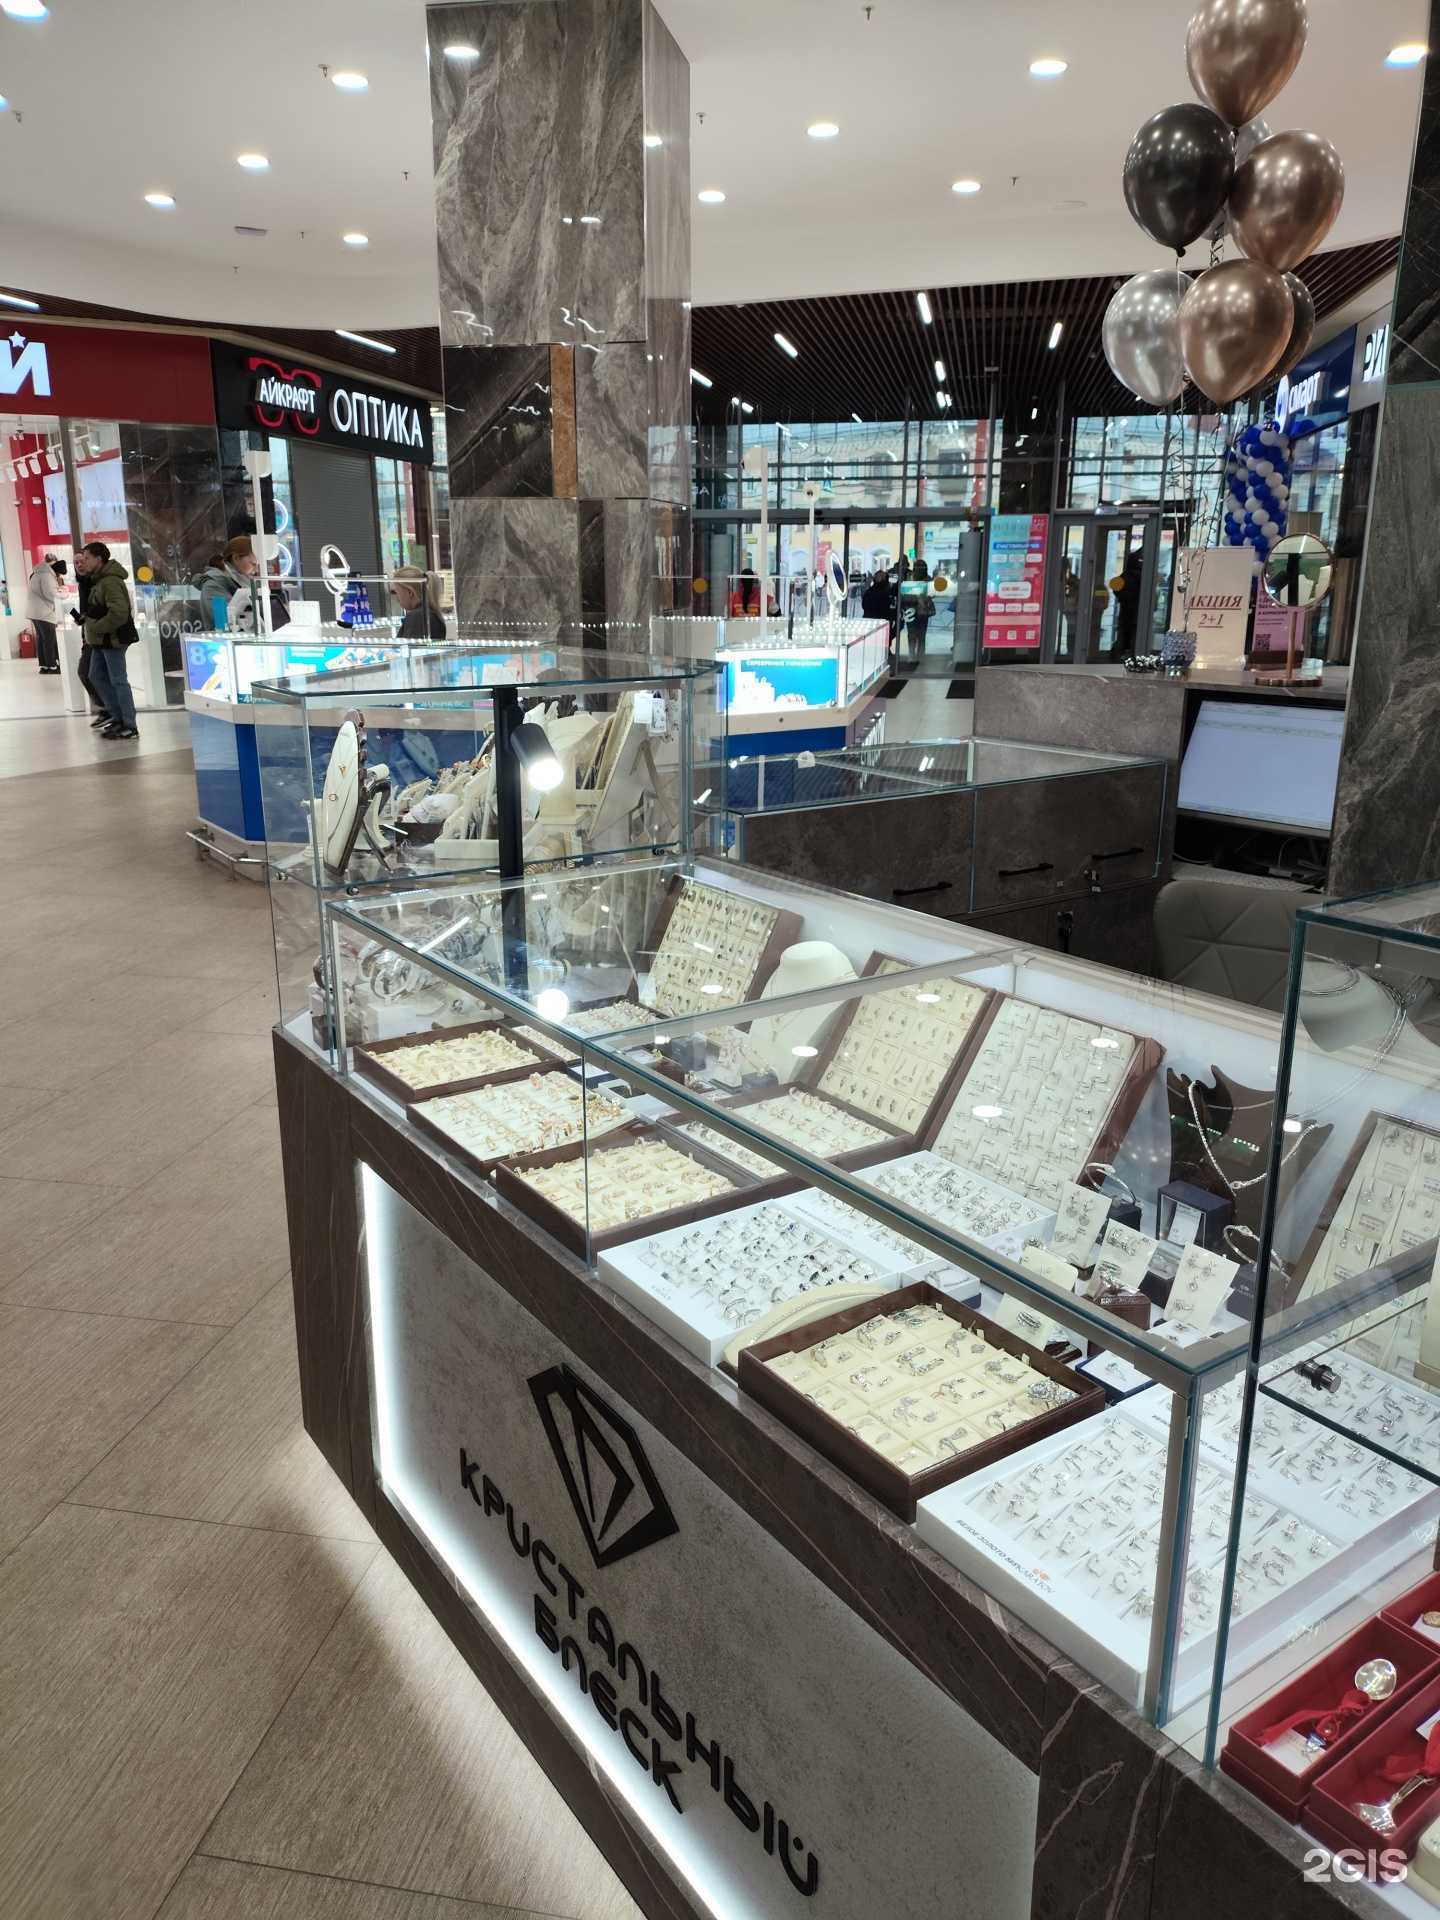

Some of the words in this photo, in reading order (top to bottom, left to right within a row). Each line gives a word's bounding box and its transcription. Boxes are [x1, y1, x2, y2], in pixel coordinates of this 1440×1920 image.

[259, 376, 316, 413] АЙКРАФТ
[333, 388, 424, 448] ОПТИКА
[1199, 613, 1224, 625] 2+1
[459, 1446, 820, 1897] КРИСТАЛЬНЫЙ
[533, 1593, 683, 1814] БЛЕСК
